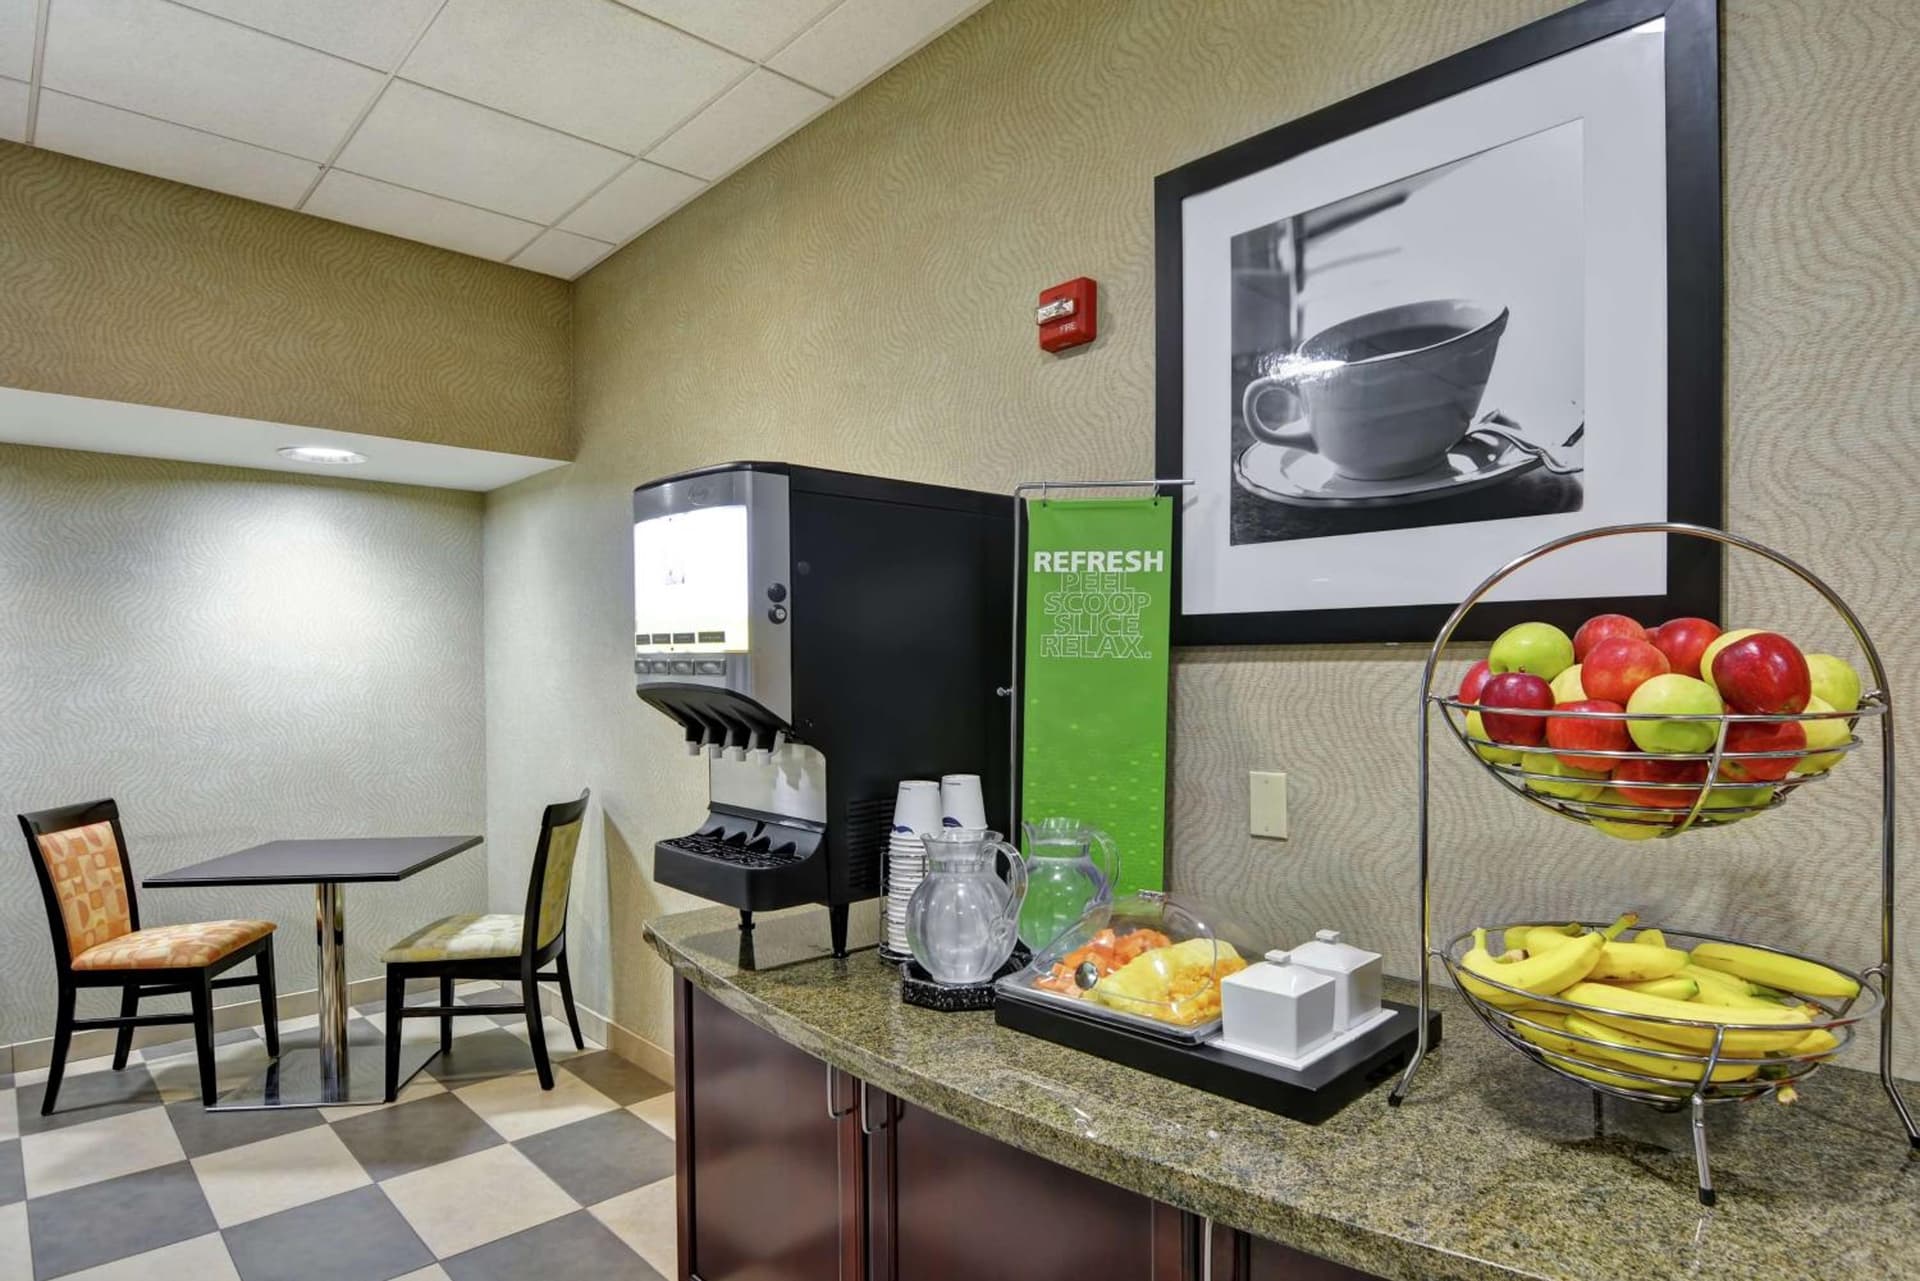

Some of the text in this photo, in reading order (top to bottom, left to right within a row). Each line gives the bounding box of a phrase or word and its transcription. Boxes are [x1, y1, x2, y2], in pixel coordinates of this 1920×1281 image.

[1034, 551, 1163, 572] REFRESH
[1061, 571, 1135, 593] PEEL
[1044, 592, 1152, 615] SCOOP
[1054, 613, 1140, 636] SLICE
[1040, 634, 1152, 658] RELAX.
